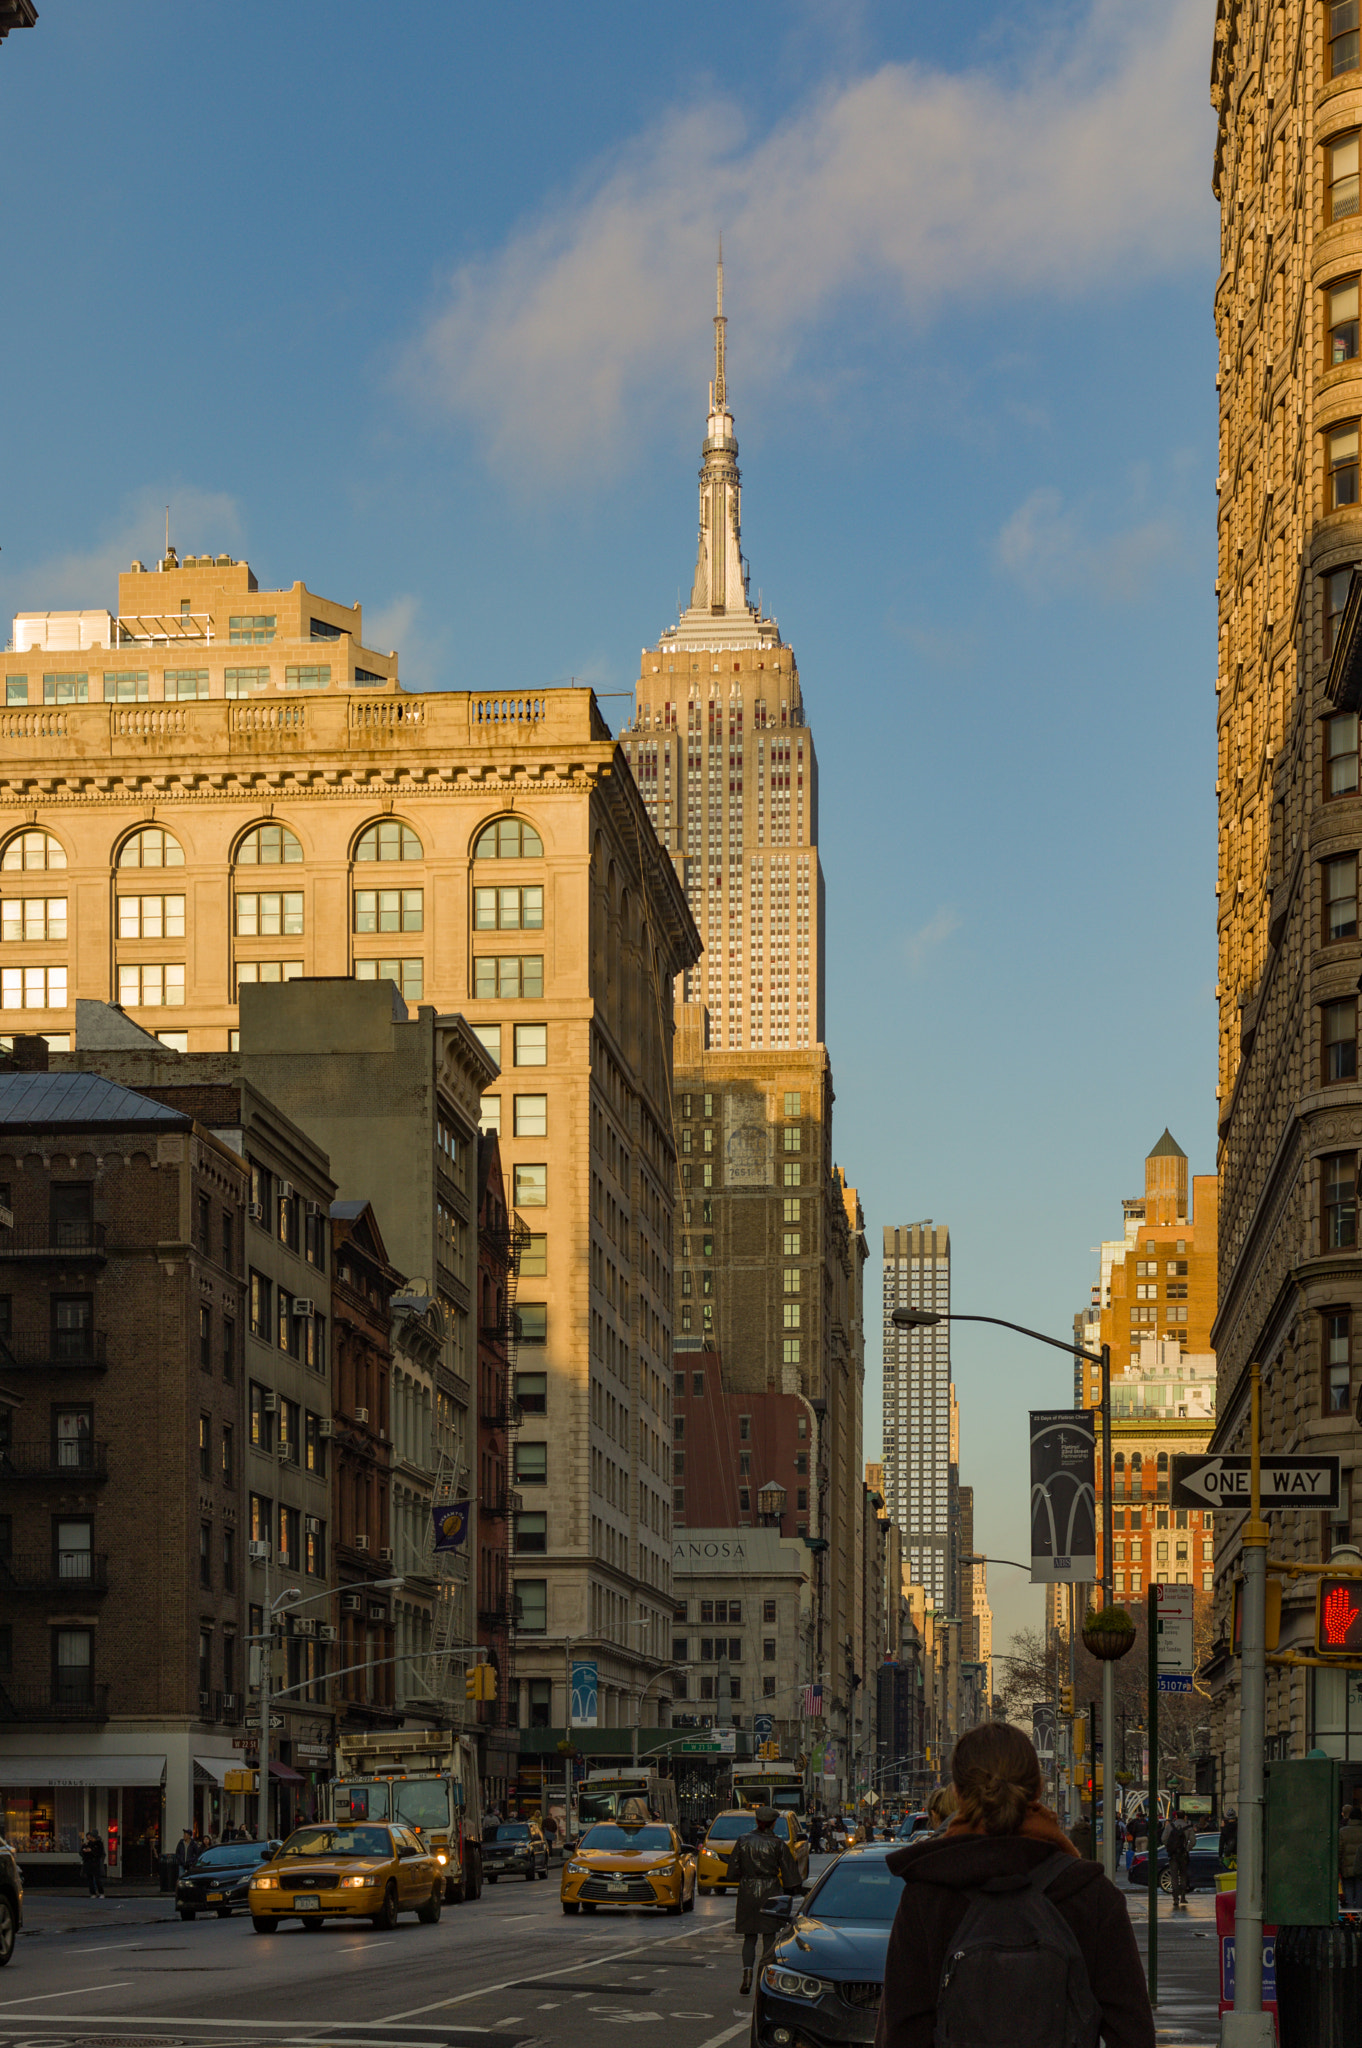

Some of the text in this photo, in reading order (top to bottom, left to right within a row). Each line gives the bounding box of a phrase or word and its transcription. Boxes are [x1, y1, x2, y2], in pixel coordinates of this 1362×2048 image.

[1204, 1472, 1321, 1492] ONE WAY
[674, 1543, 745, 1557] ANOSA
[758, 1776, 789, 1785] LIMITED
